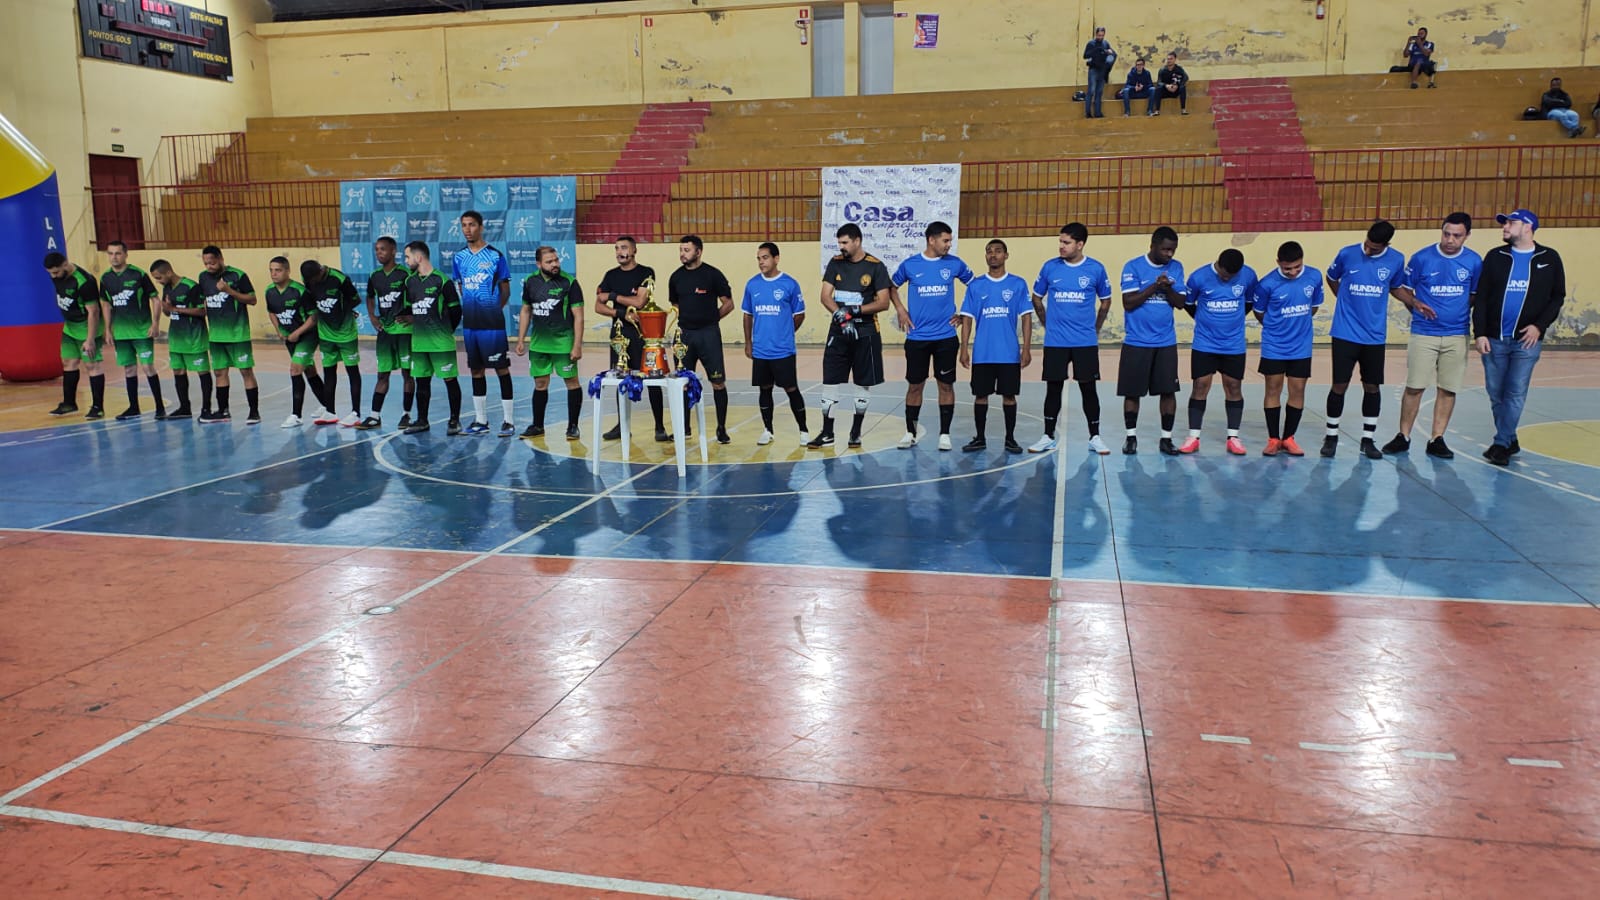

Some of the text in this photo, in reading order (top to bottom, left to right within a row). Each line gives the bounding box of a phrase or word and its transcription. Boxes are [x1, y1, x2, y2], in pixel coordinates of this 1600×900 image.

[844, 201, 914, 222] Casa
[918, 285, 948, 294] MUNDIAL
[1349, 283, 1383, 294] MUNDIAL
[1430, 285, 1465, 294] MUNDIAL
[1054, 291, 1086, 300] MUNDIAL
[1207, 300, 1240, 308] MUNDIAL
[755, 305, 781, 313] MUNDIAL
[982, 306, 1010, 315] MUNDIAL
[1281, 304, 1311, 315] MUNDIAL
